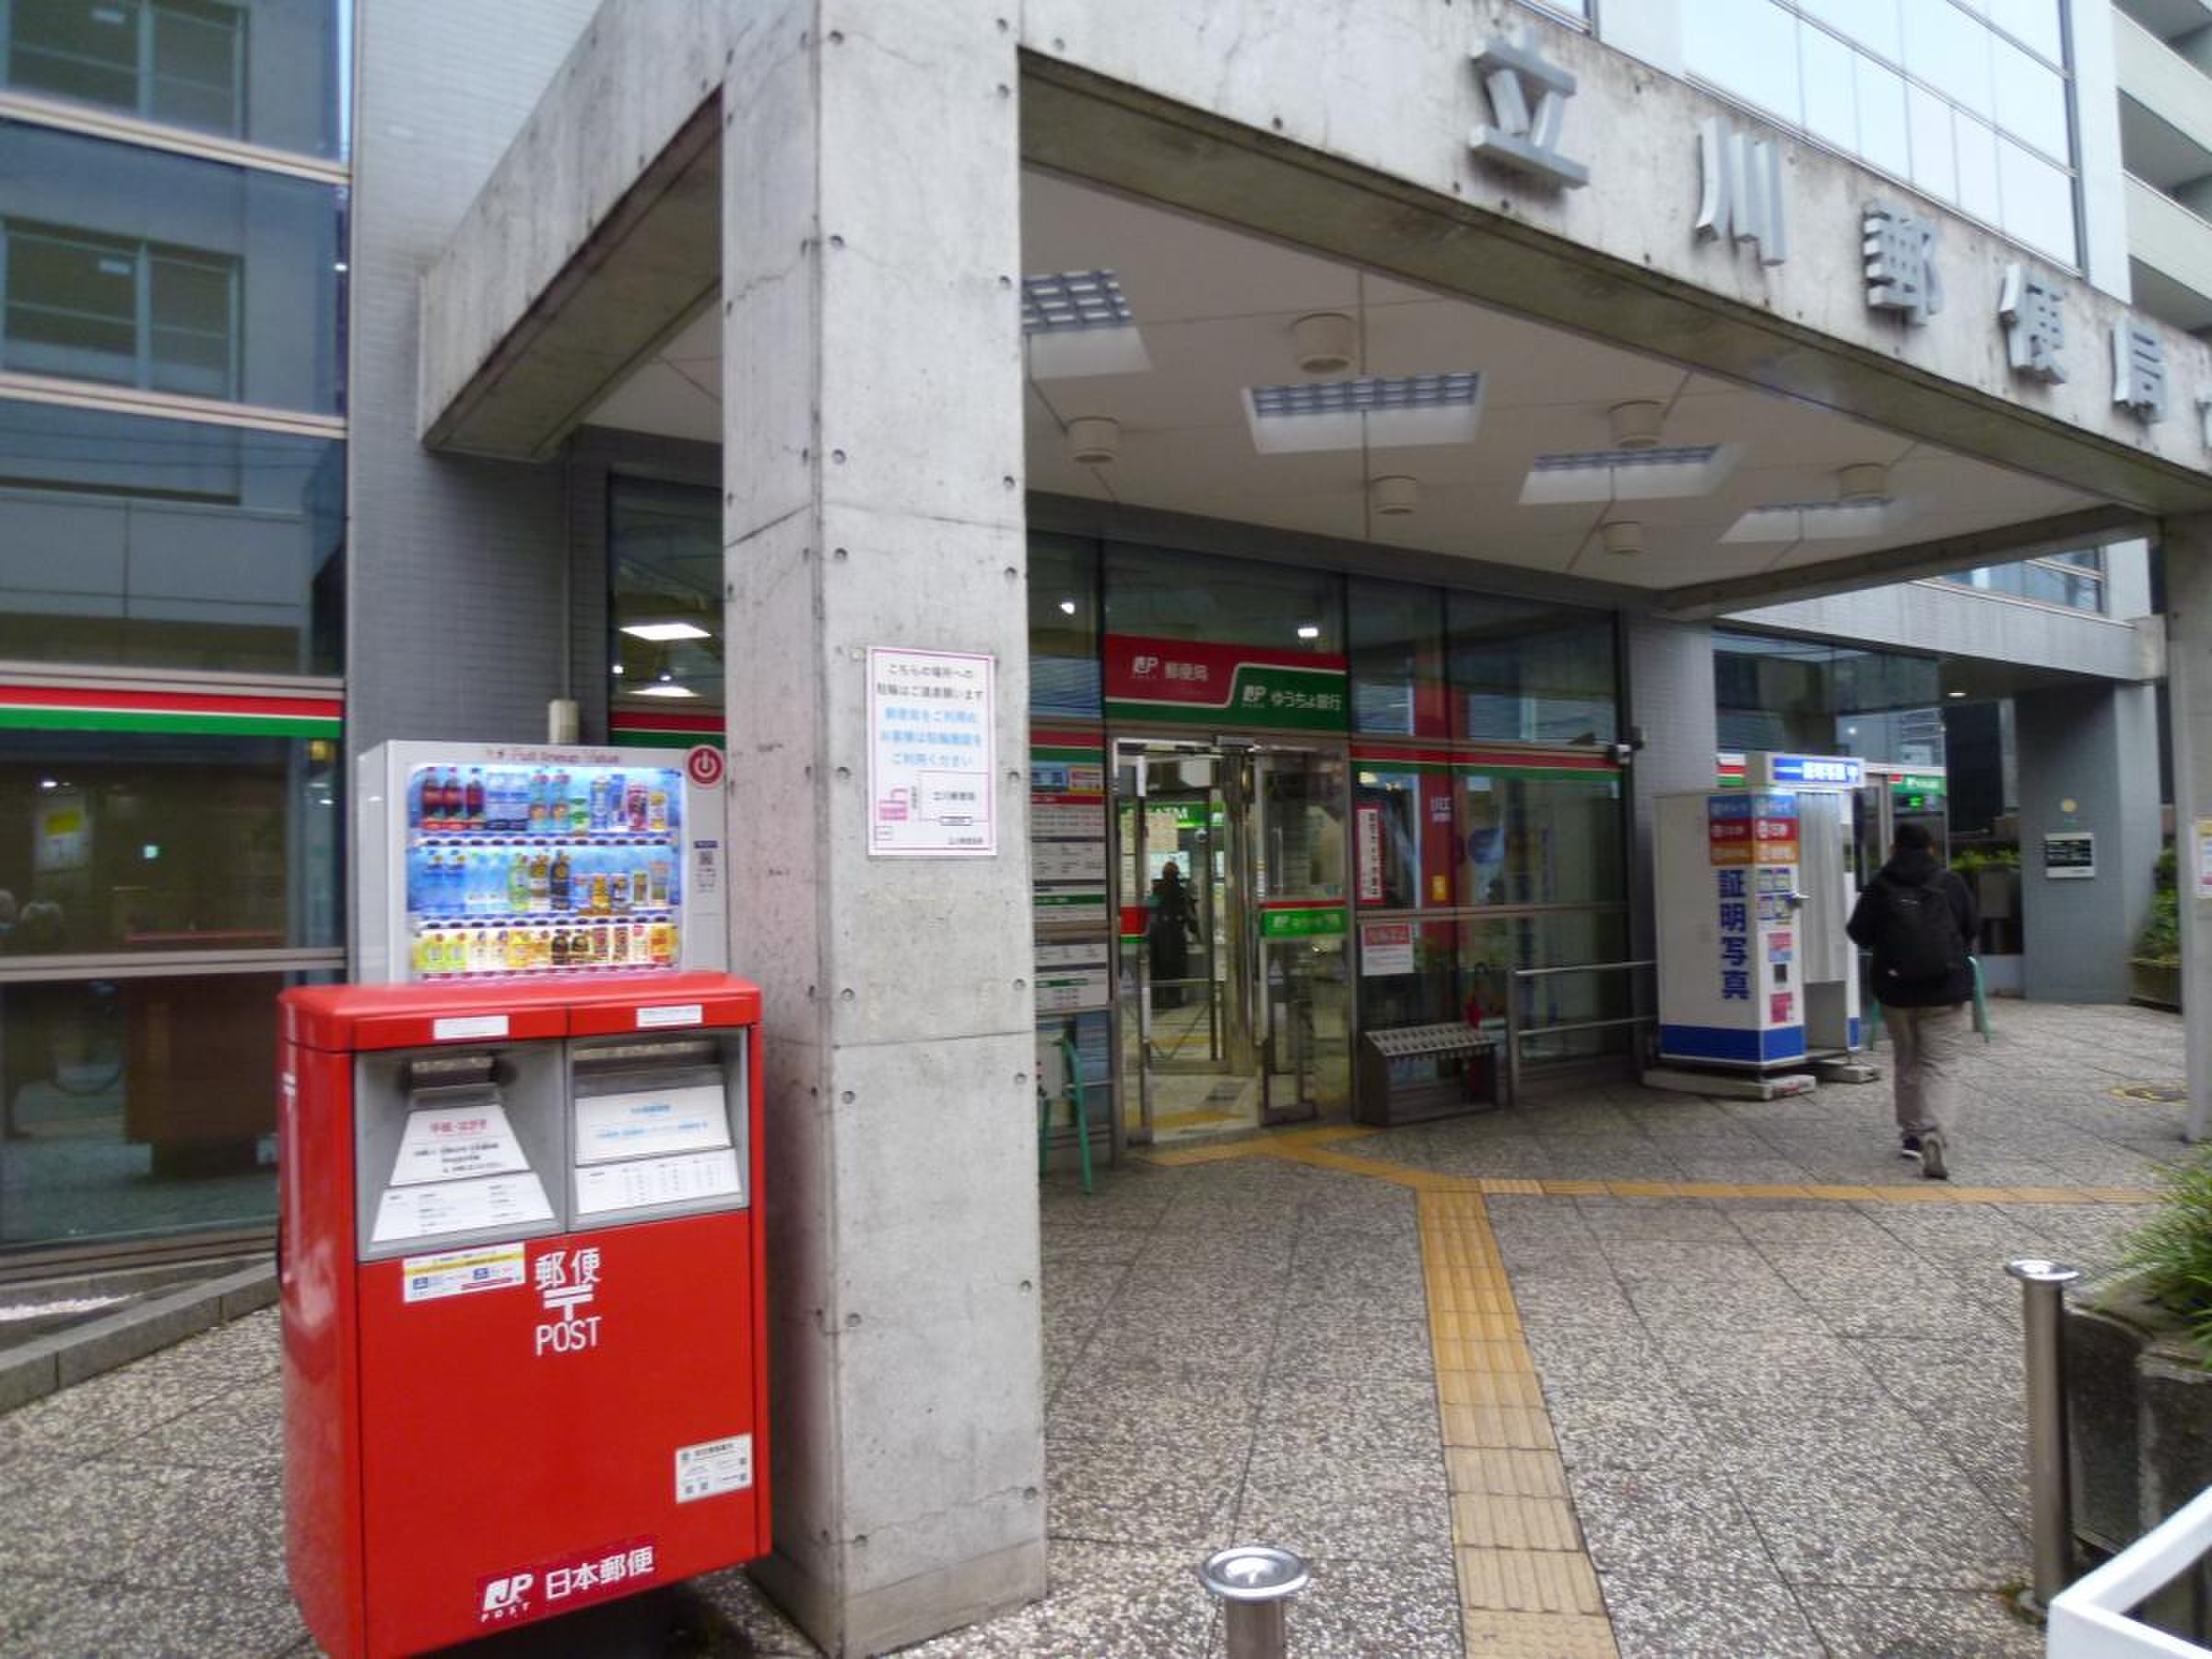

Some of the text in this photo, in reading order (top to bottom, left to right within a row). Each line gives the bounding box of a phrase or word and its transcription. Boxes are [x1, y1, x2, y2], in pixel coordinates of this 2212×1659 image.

[1469, 28, 2168, 420] 立川郵便局
[1717, 868, 1750, 1001] 証明写真
[535, 1247, 601, 1290] 郵便
[535, 1316, 601, 1357] POST
[546, 1546, 655, 1601] 日本郵便
